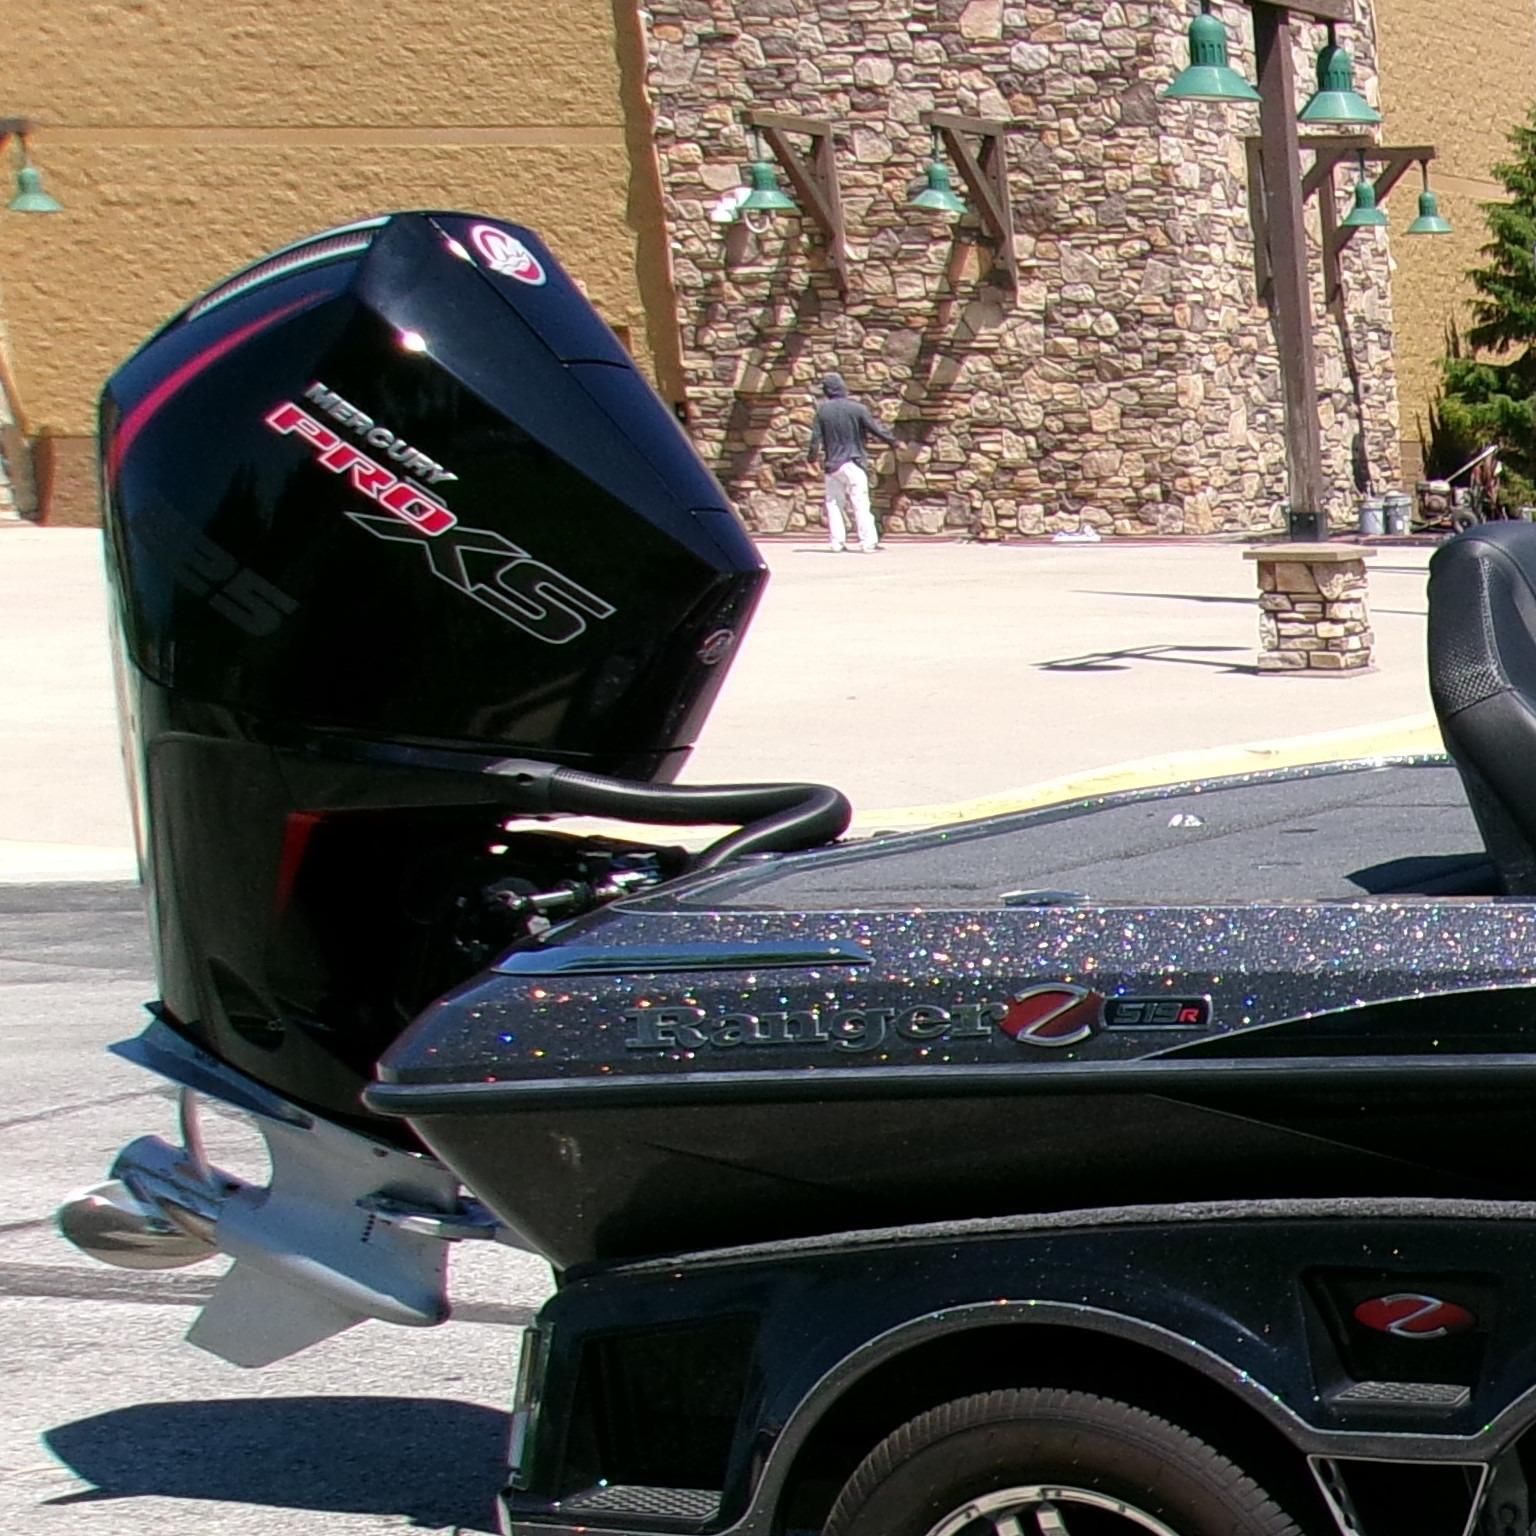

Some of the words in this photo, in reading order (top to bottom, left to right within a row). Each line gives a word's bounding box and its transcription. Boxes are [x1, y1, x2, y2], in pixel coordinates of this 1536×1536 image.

[265, 401, 458, 537] PRO
[304, 381, 460, 484] MERCURY
[343, 505, 618, 645] XS
[624, 1001, 1008, 1053] Ranger
[1013, 982, 1092, 1048] Z
[1382, 1292, 1448, 1339] Z
